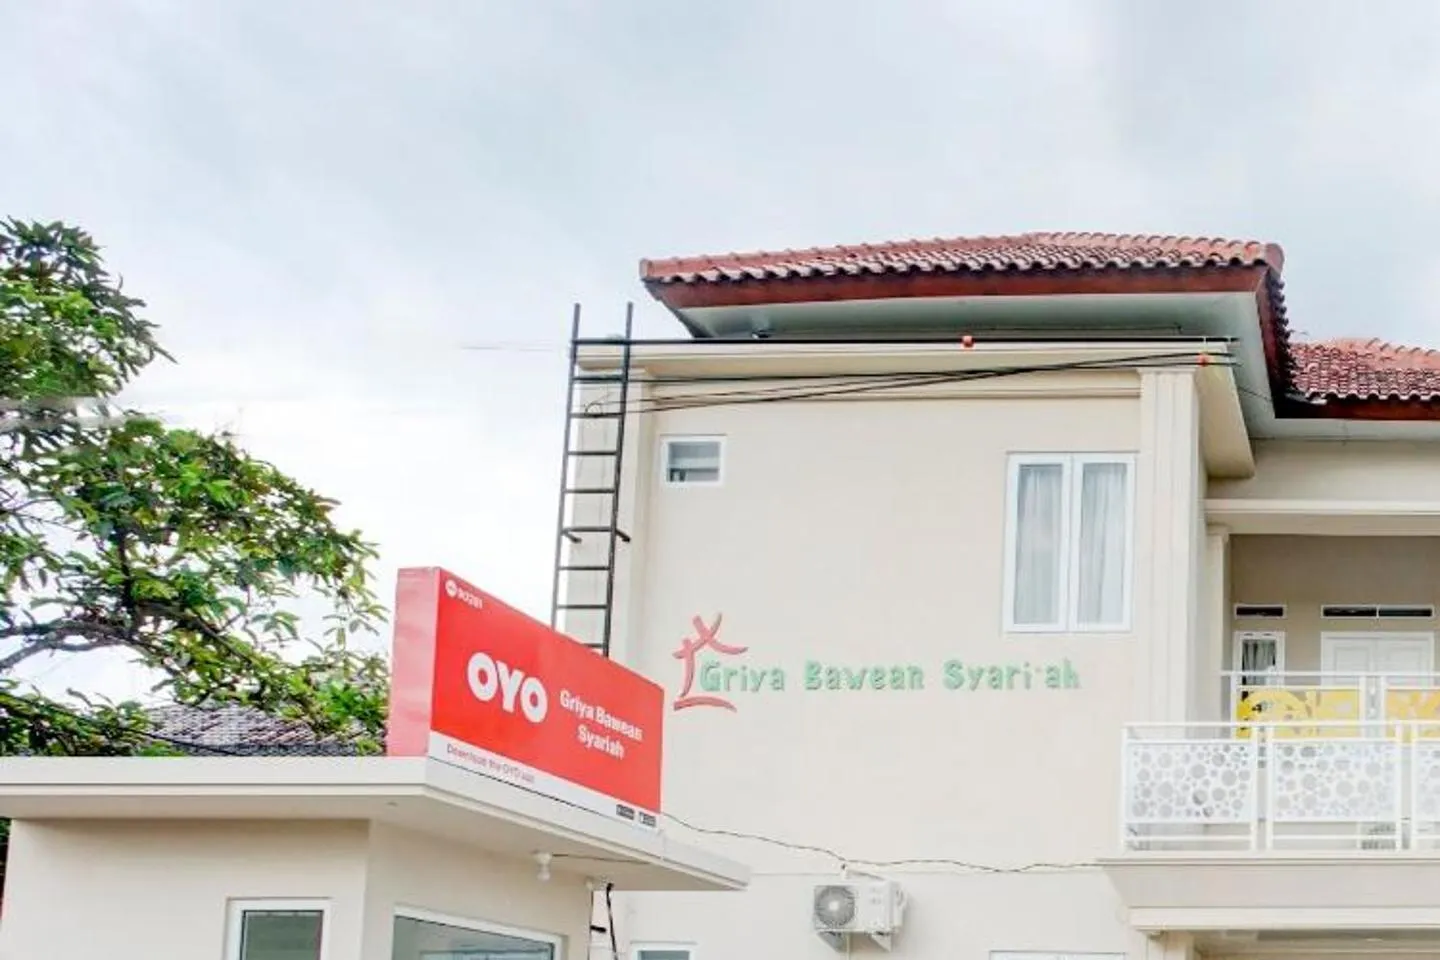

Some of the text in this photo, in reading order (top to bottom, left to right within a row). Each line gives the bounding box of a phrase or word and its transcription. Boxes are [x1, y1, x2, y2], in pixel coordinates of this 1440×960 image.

[467, 652, 548, 723] OYO
[700, 660, 785, 692] Griya
[804, 660, 924, 691] Bawean
[559, 688, 595, 720] Griya
